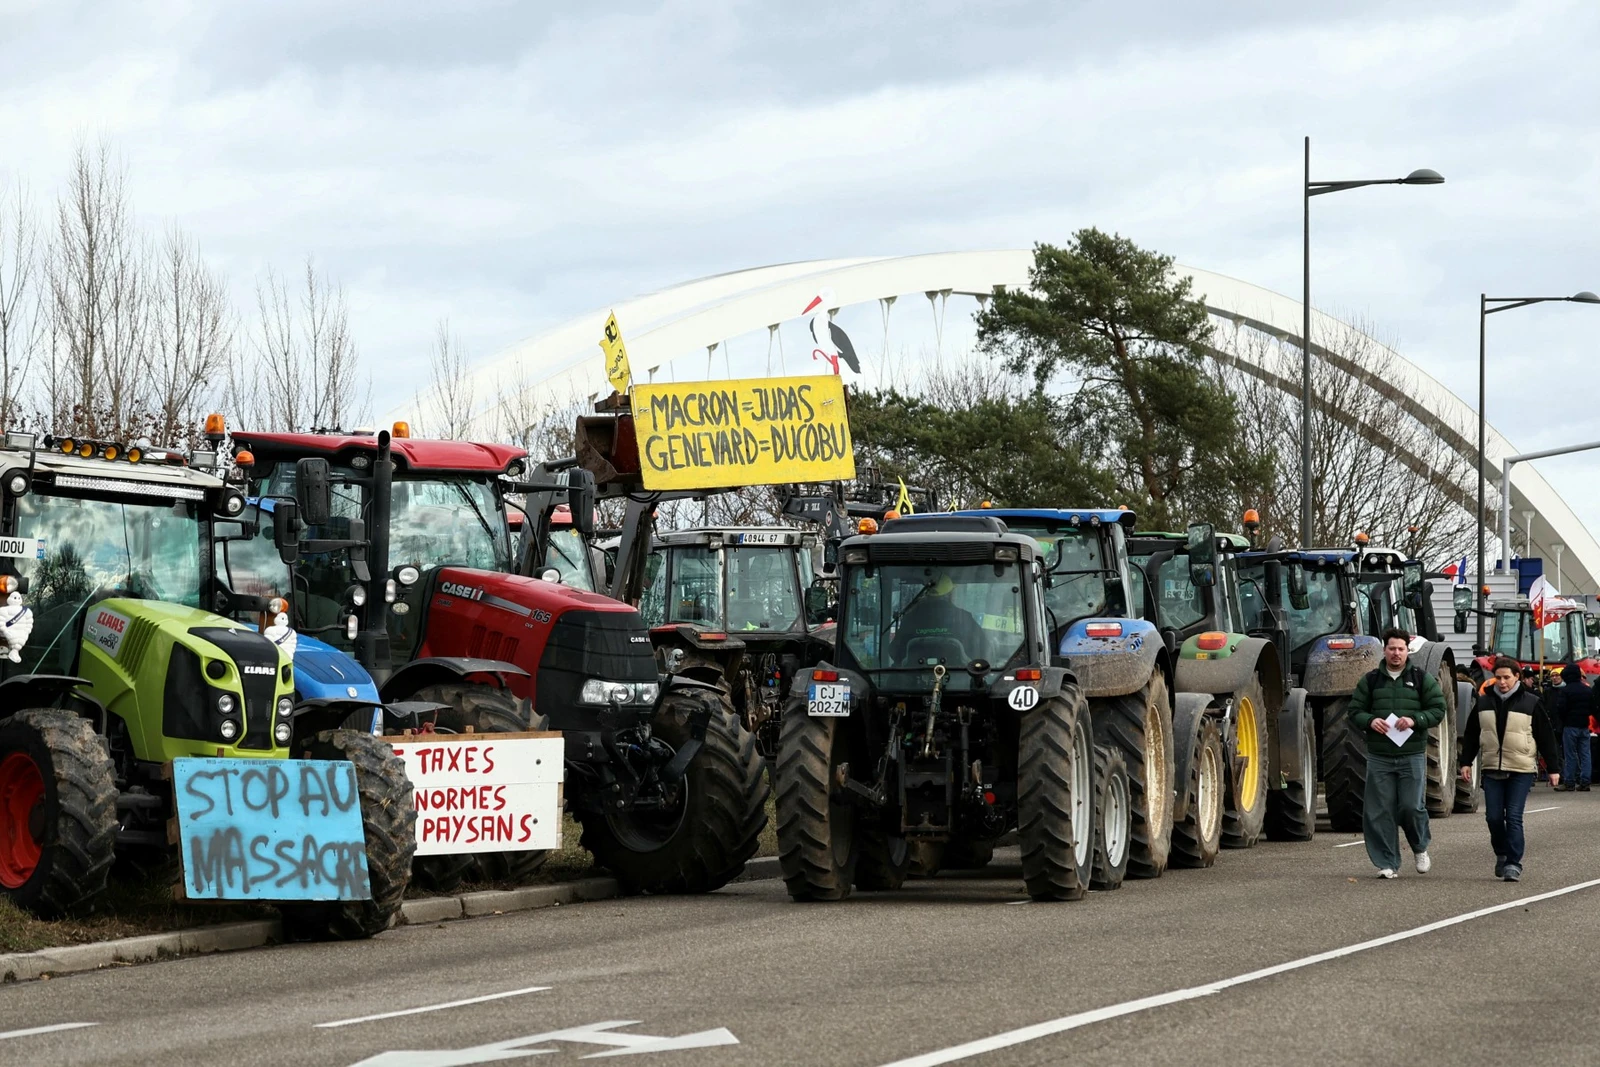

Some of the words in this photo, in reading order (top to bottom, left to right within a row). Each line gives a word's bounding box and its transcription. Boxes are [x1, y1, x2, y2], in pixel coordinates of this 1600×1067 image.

[441, 581, 473, 599] CASE
[97, 611, 125, 634] CLAAS
[532, 609, 552, 623] 165
[98, 635, 116, 650] ARION
[244, 666, 275, 675] CLAAS
[810, 701, 849, 713] 202-ZM
[1013, 688, 1034, 708] 40
[415, 746, 495, 775] TAXES
[185, 765, 290, 821] STOP
[298, 764, 357, 817] AU
[415, 785, 507, 812] NORMES
[422, 813, 533, 844] PAYSANS
